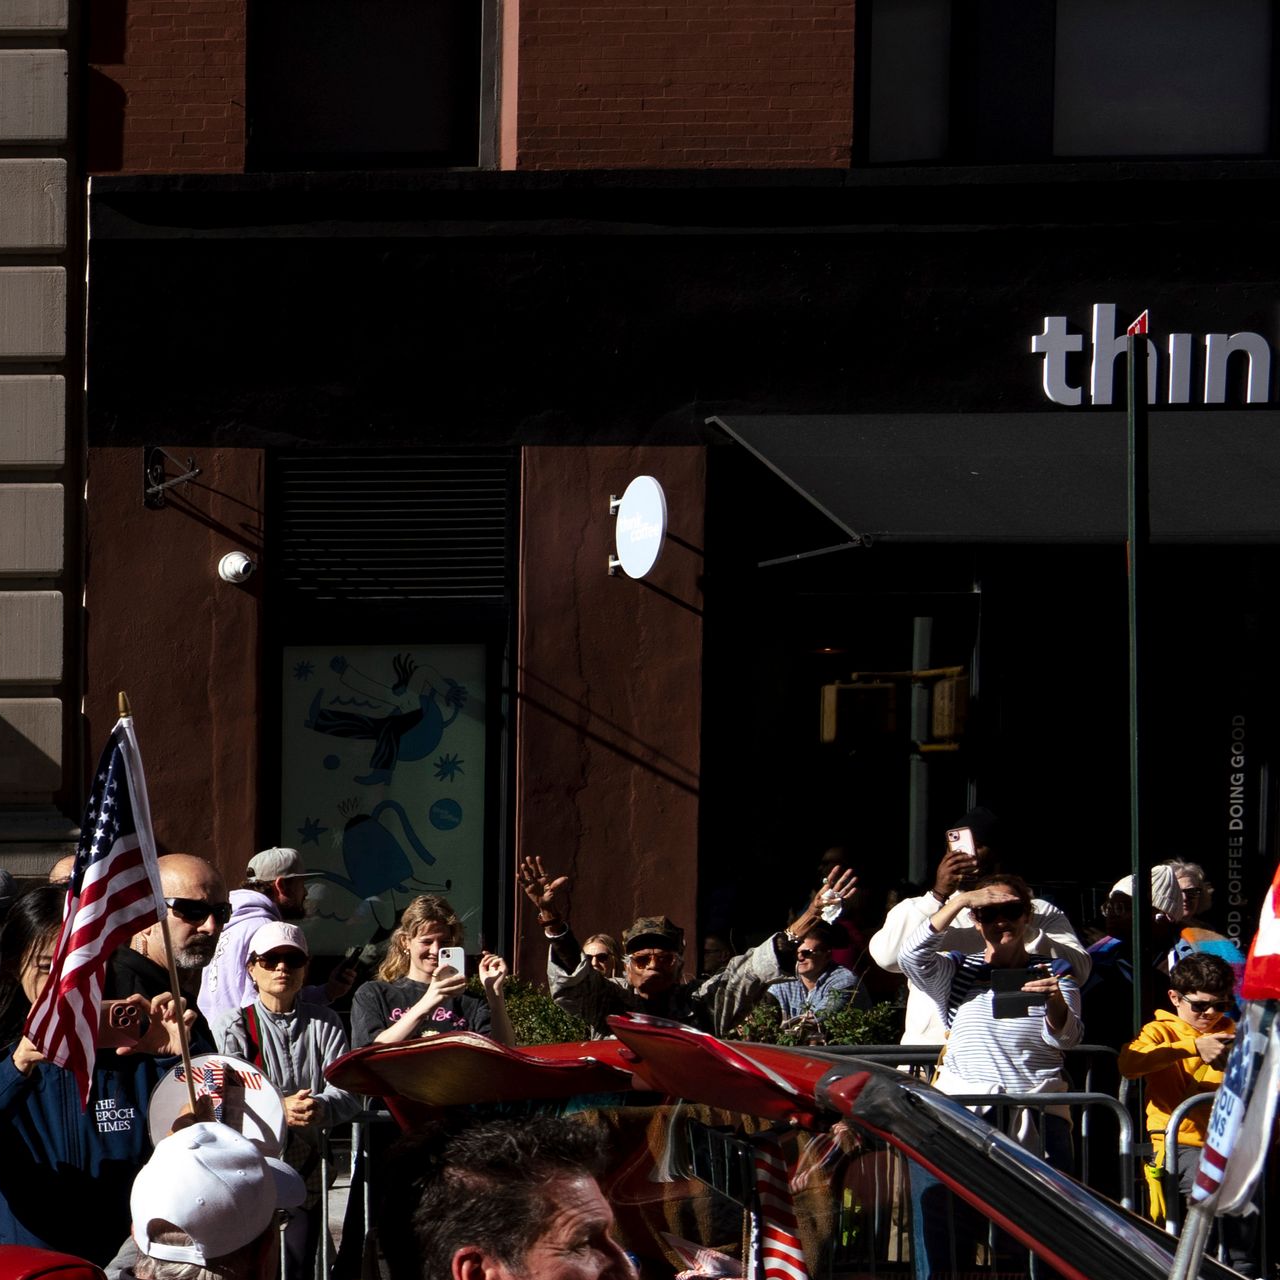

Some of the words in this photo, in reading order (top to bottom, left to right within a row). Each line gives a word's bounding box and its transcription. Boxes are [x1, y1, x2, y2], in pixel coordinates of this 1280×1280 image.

[1230, 713, 1246, 768] GOOD
[1229, 772, 1245, 831] DOING
[1228, 836, 1244, 906] COFFEE
[95, 1099, 116, 1110] THE
[95, 1108, 135, 1121] EPOCH
[97, 1120, 131, 1133] TIMES
